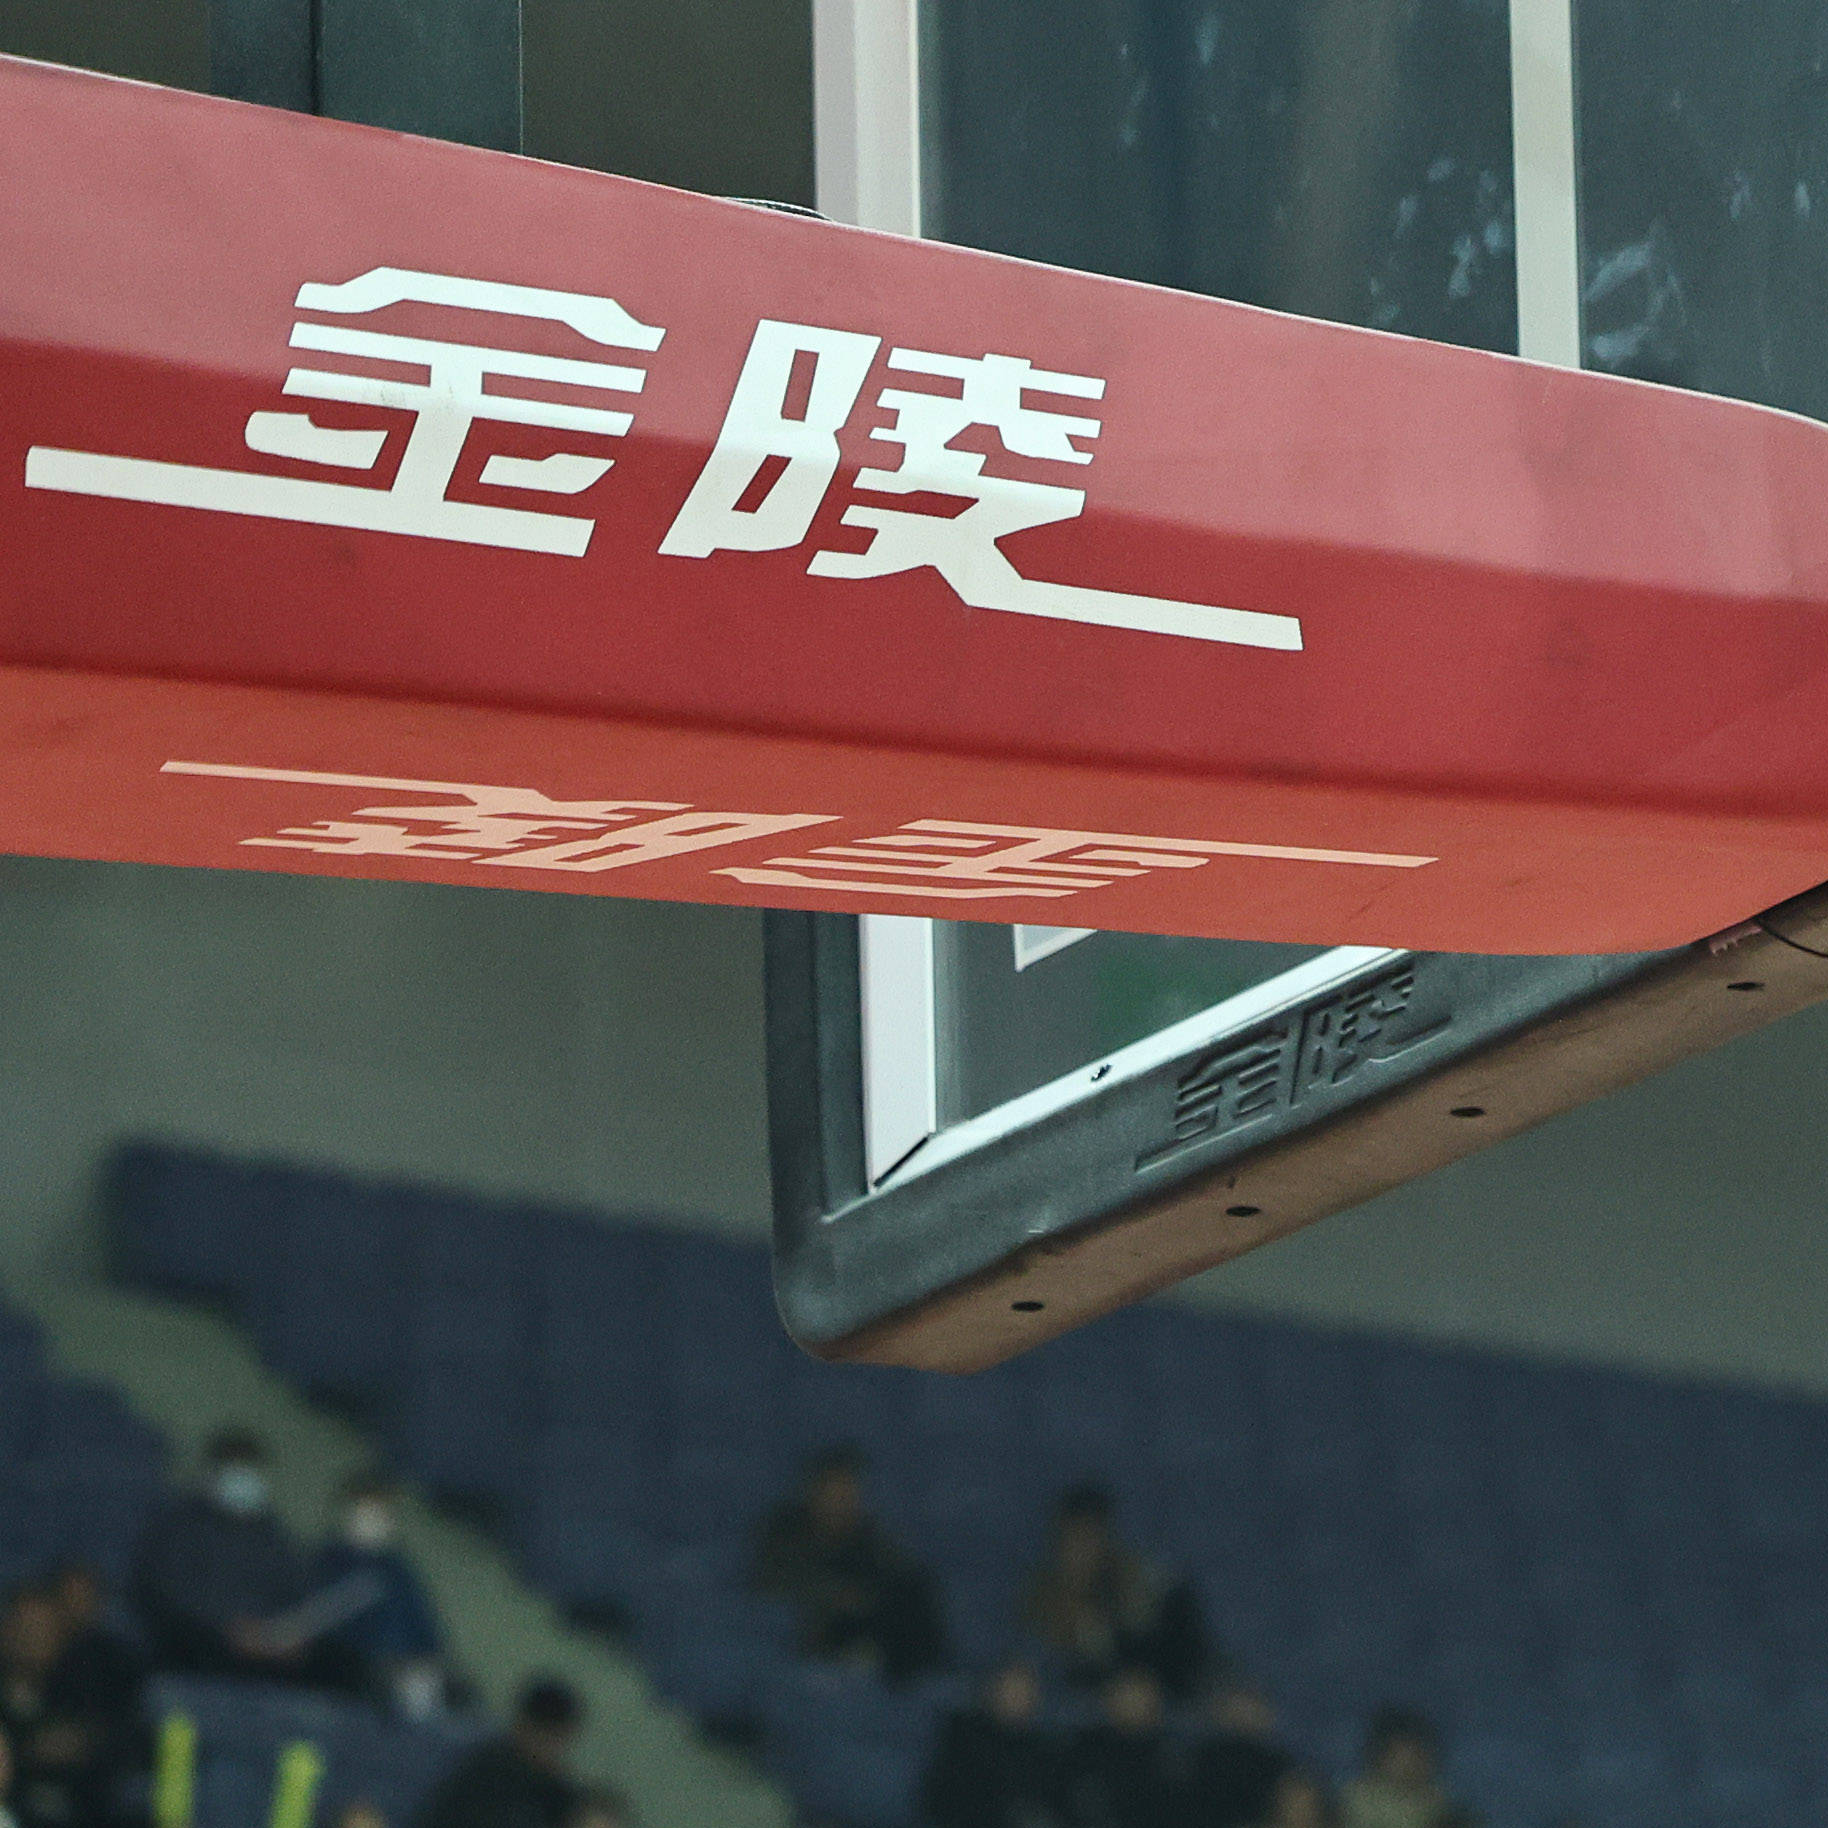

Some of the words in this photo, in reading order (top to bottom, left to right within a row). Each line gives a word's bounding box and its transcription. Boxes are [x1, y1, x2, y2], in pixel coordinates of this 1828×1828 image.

[26, 267, 1303, 650] 金陵
[160, 760, 1439, 898] 金陵
[1134, 958, 1452, 1173] 金陵
